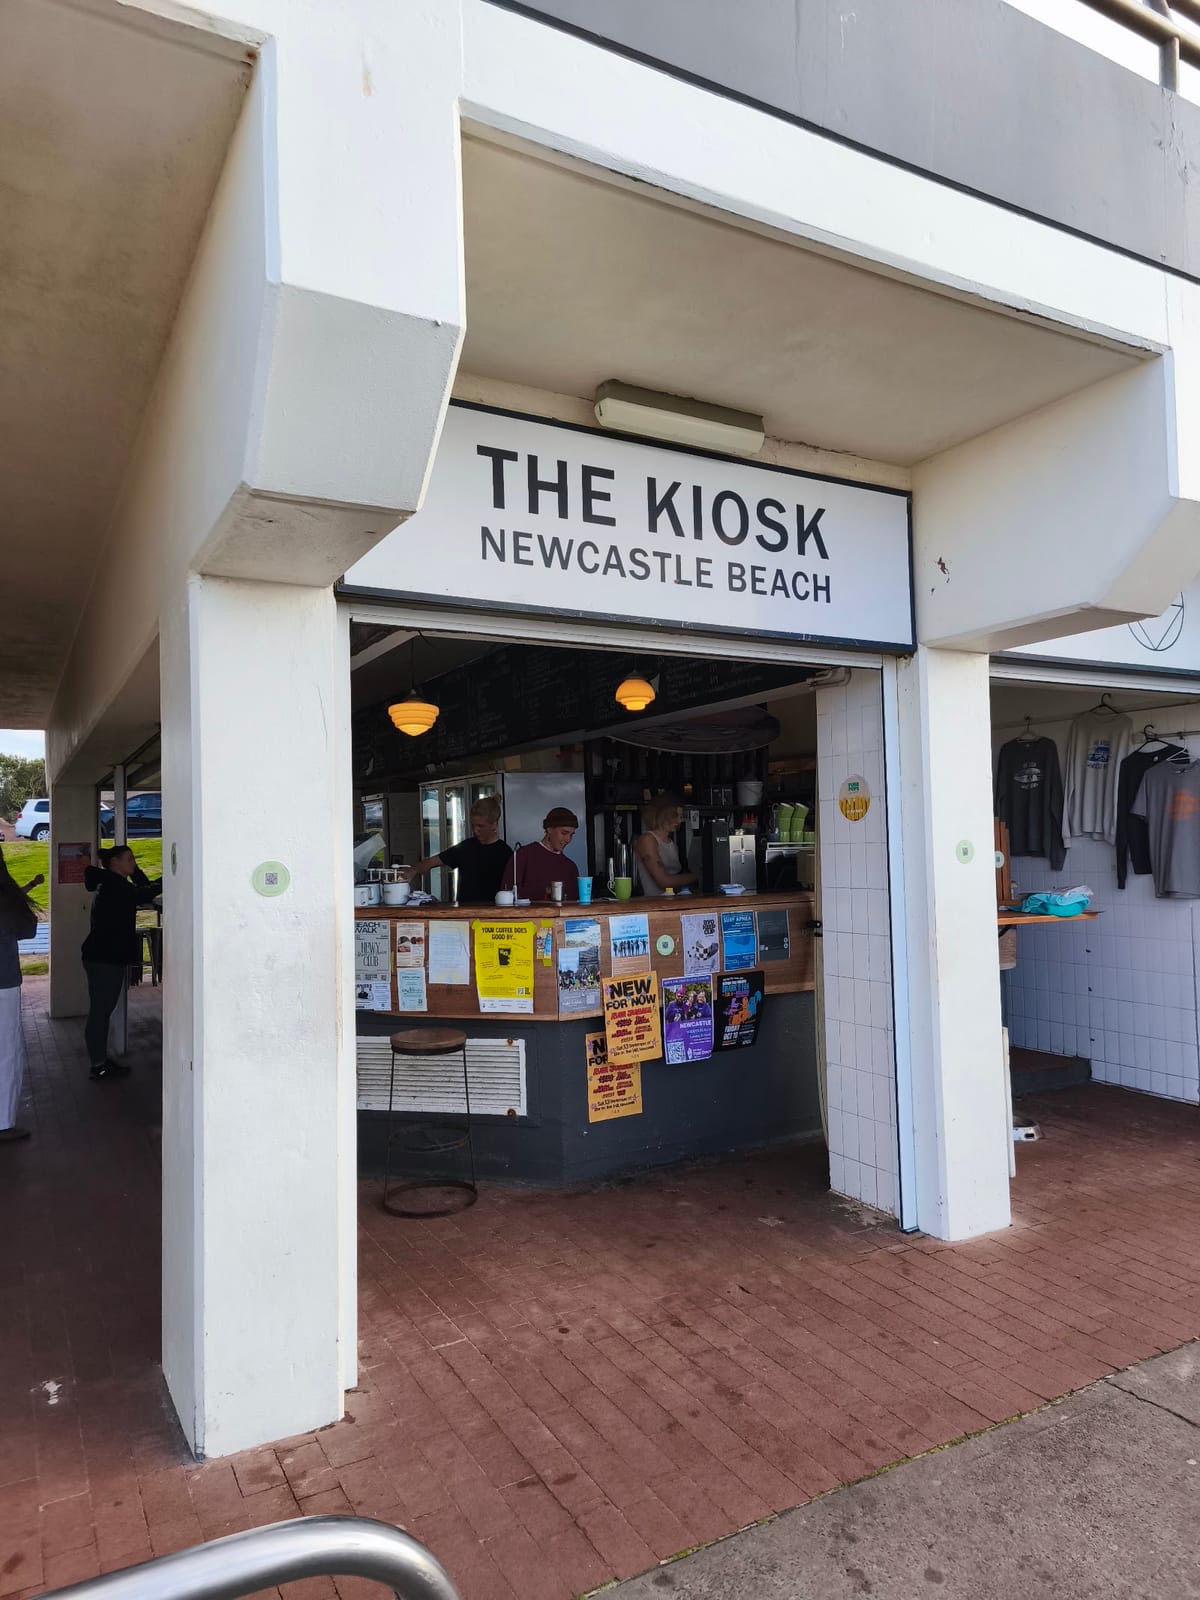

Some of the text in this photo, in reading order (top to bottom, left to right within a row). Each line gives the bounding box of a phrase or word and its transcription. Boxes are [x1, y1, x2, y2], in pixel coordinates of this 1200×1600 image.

[476, 444, 830, 560] THE KIOSK
[480, 526, 832, 604] NEWCASTLE BEACH
[609, 978, 652, 1000] NEW
[606, 999, 628, 1011] FOR
[631, 994, 657, 1008] NOW
[680, 1020, 712, 1029] NEWCASTLE
